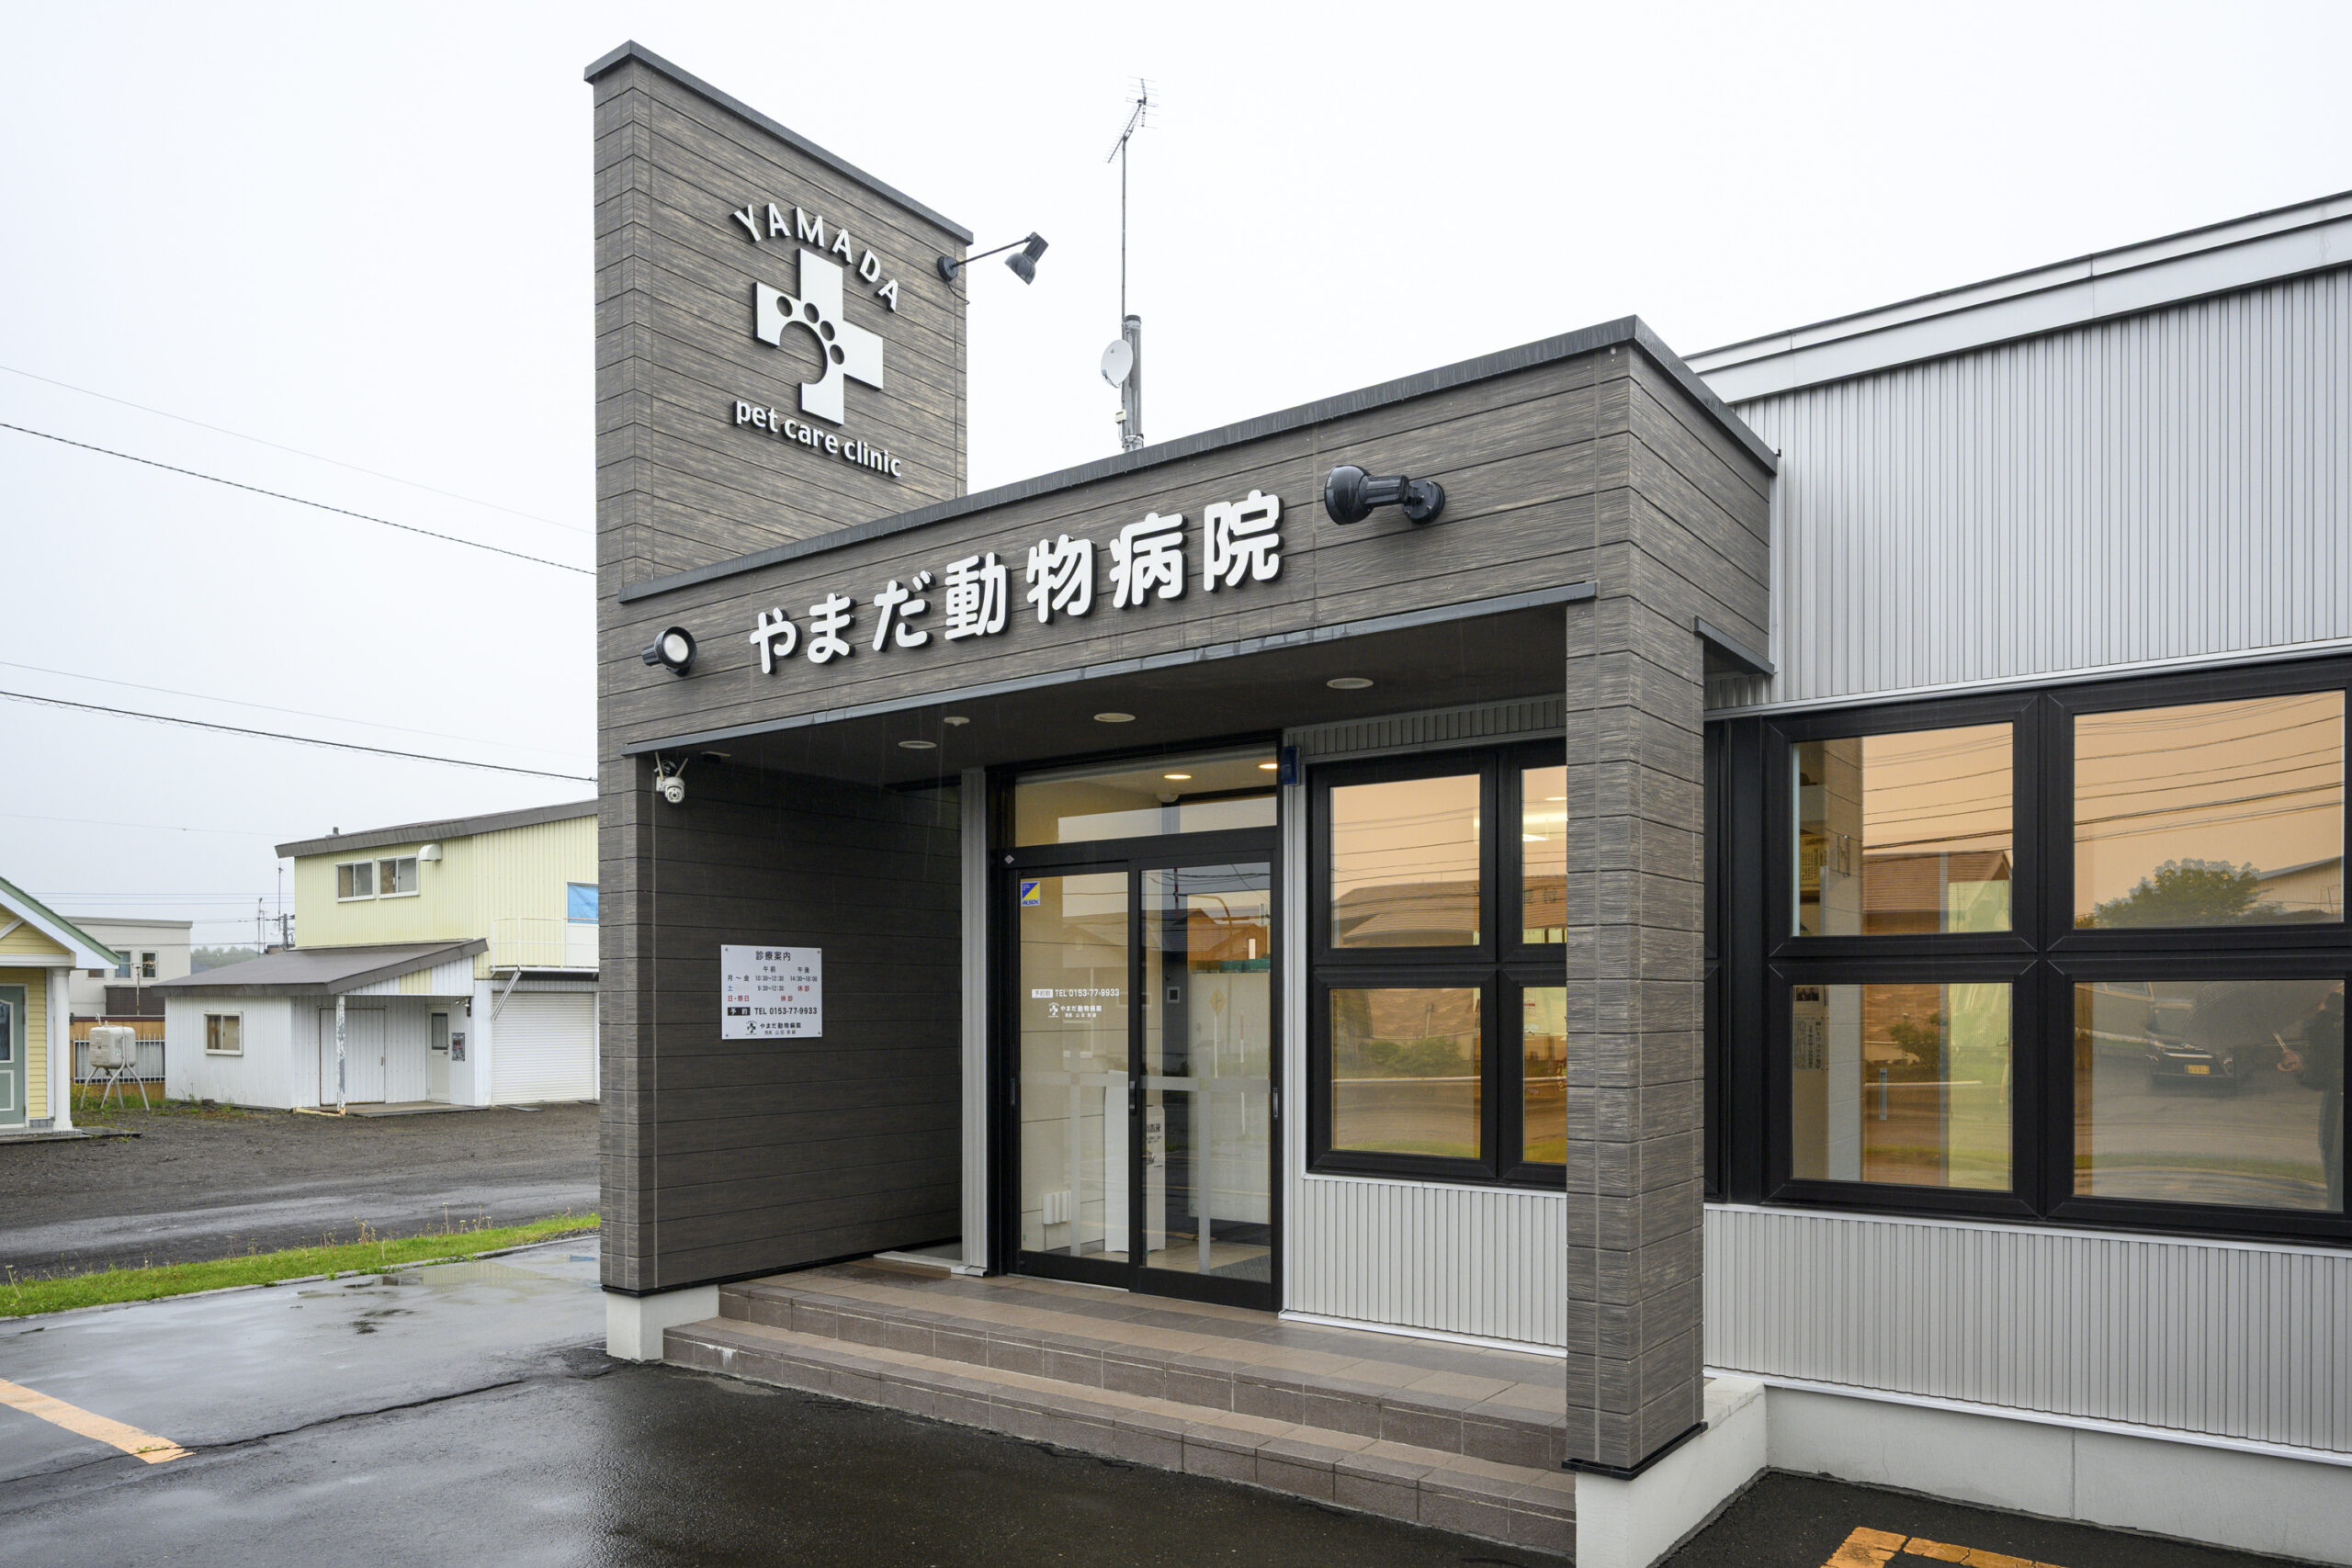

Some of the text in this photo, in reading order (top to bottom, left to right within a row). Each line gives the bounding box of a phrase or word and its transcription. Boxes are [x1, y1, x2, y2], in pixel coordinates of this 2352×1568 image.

[732, 203, 899, 312] YAMADA
[735, 400, 902, 478] pet care clinic
[749, 490, 1284, 676] やまだ動物病院
[755, 950, 791, 962] 診療案内
[763, 965, 776, 974] 午前
[1055, 988, 1068, 998] TEL
[753, 1007, 767, 1015] TEL
[769, 1007, 818, 1015] 0153-77-9933
